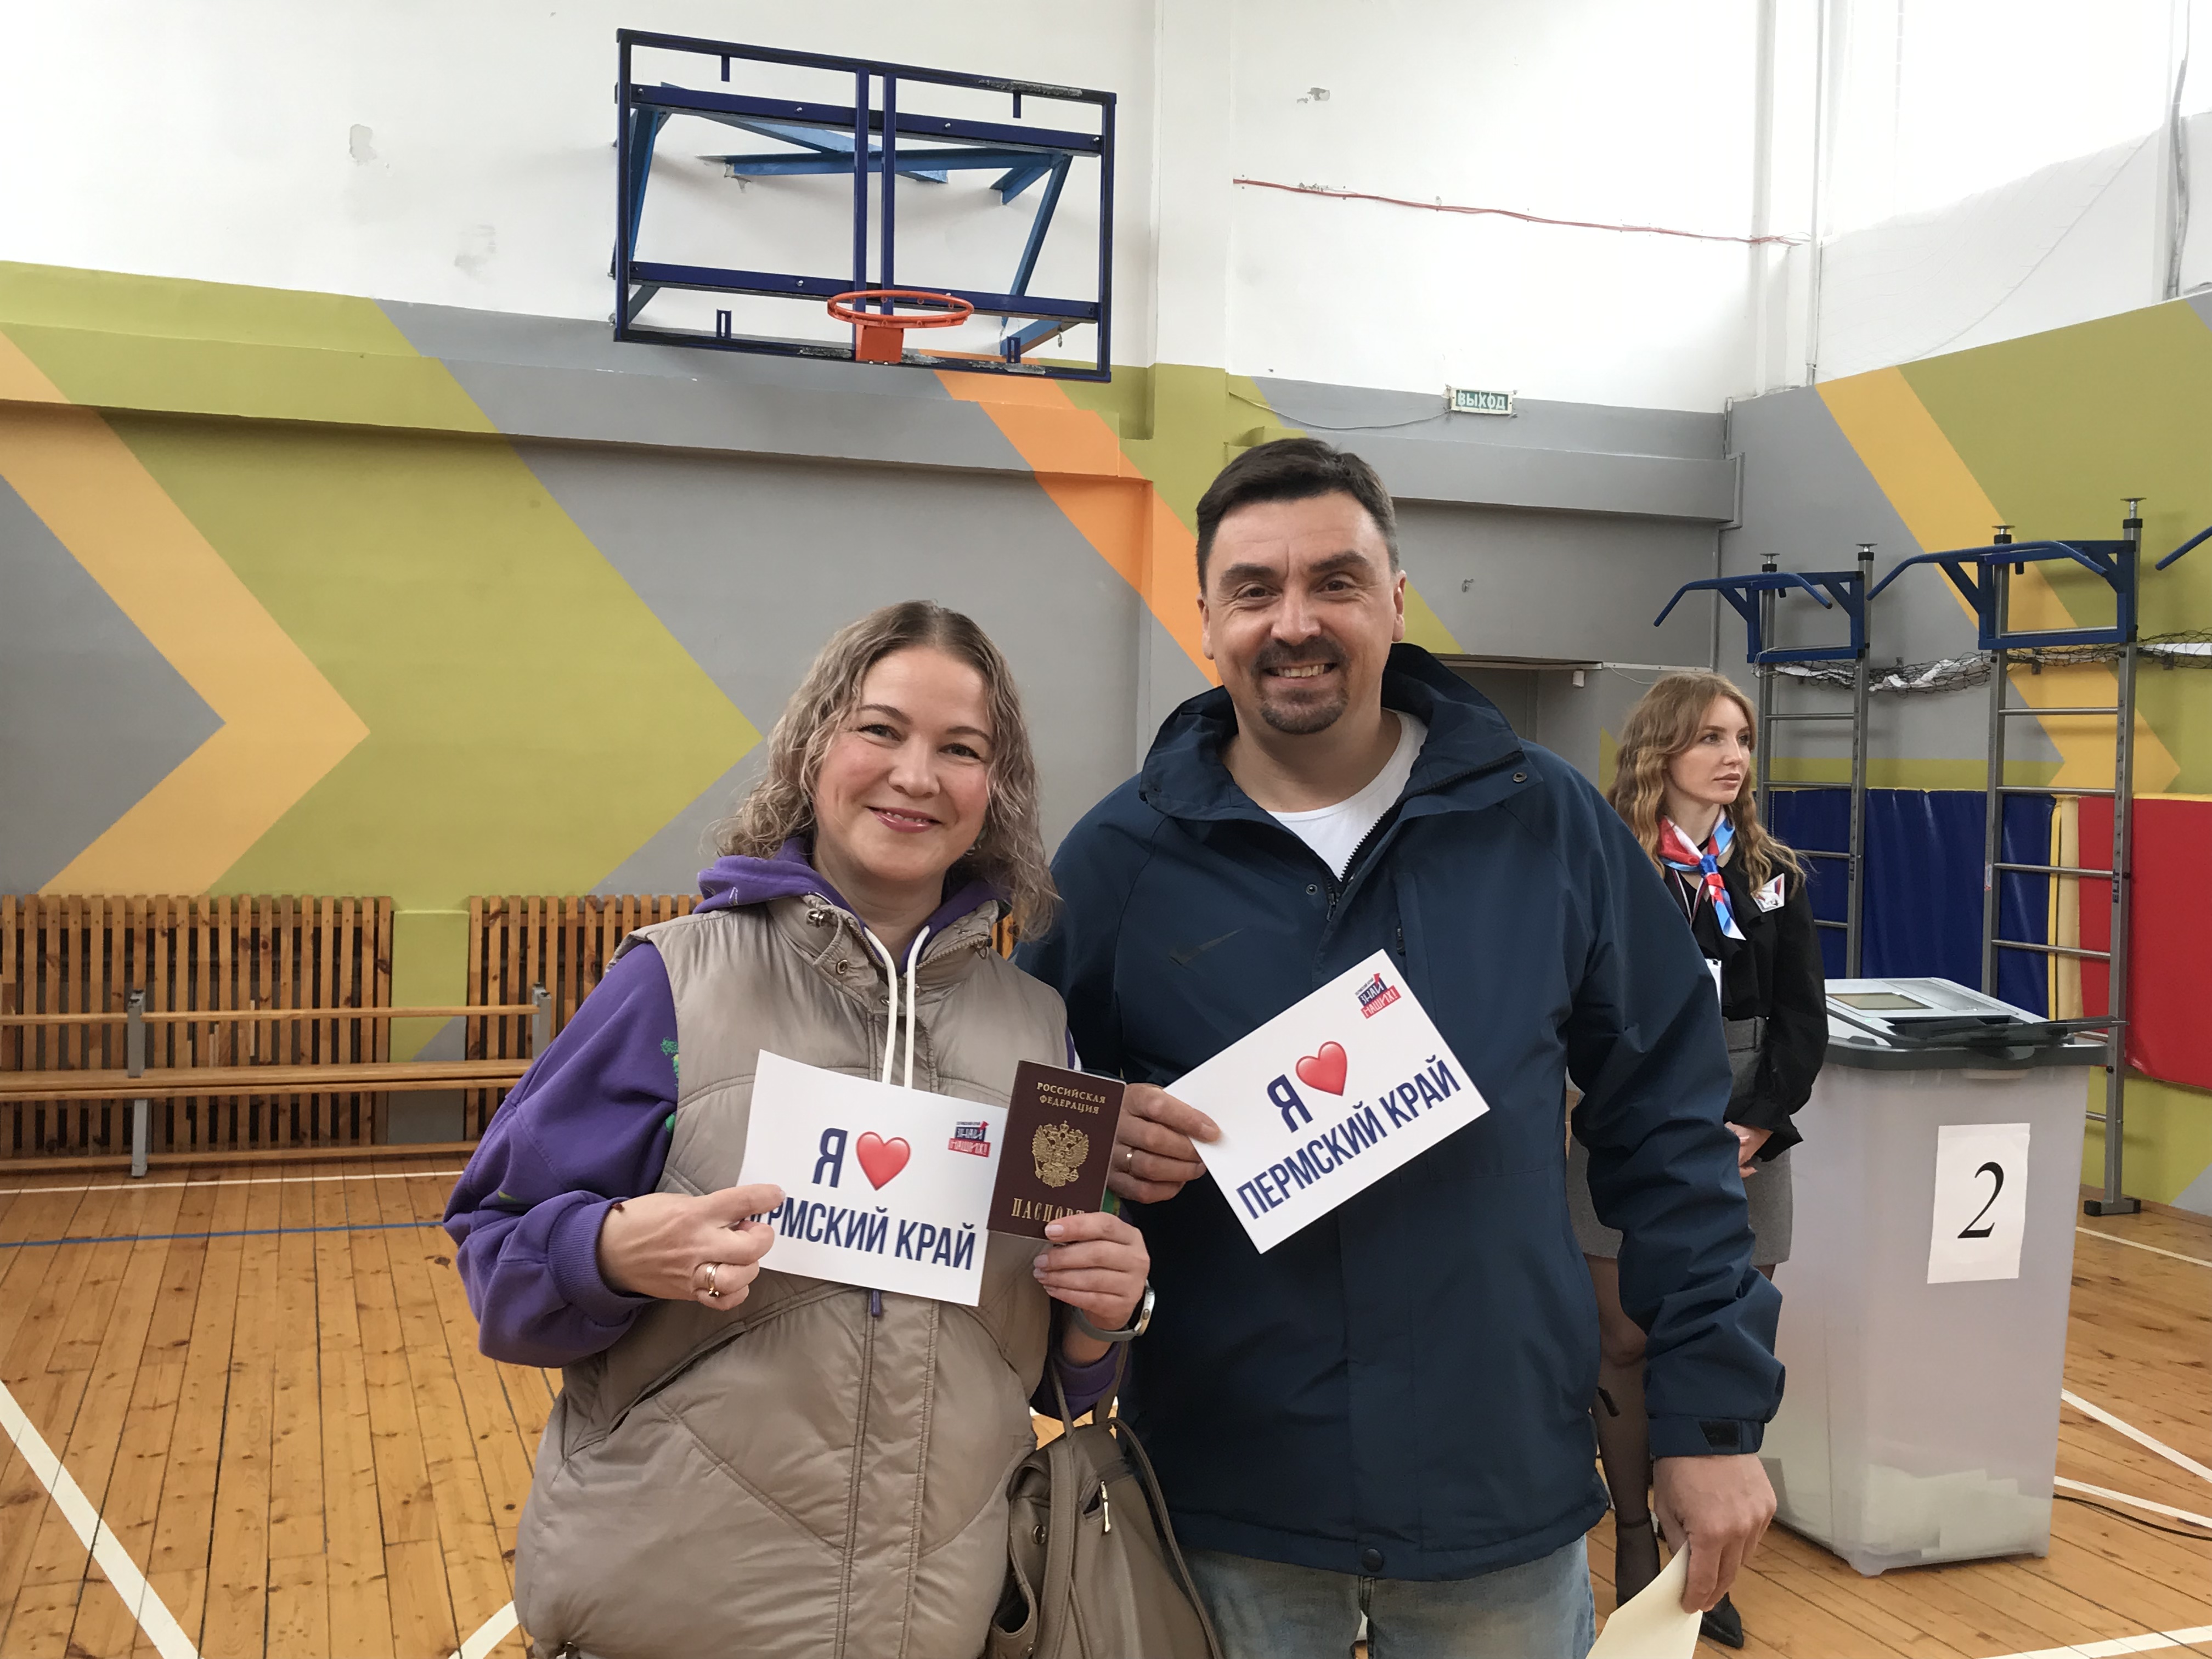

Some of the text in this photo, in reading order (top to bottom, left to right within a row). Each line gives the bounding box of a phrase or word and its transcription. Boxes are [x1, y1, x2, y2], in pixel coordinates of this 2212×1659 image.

[1458, 392, 1505, 410] ВЫХОД
[1363, 989, 1398, 1017] НАШИХ!
[1036, 1082, 1106, 1104] РОССИЙСКАЯ
[1040, 1094, 1099, 1114] ФЕДЕРАЦИЯ
[1267, 1074, 1313, 1133] Я
[812, 1128, 848, 1188] Я
[1236, 1054, 1462, 1220] ПЕРМСКИЙ КРАЙ
[1011, 1198, 1085, 1222] ПАСПО
[1957, 1161, 2004, 1239] 2
[747, 1197, 975, 1271] РМСКИЙ КРАЙ
